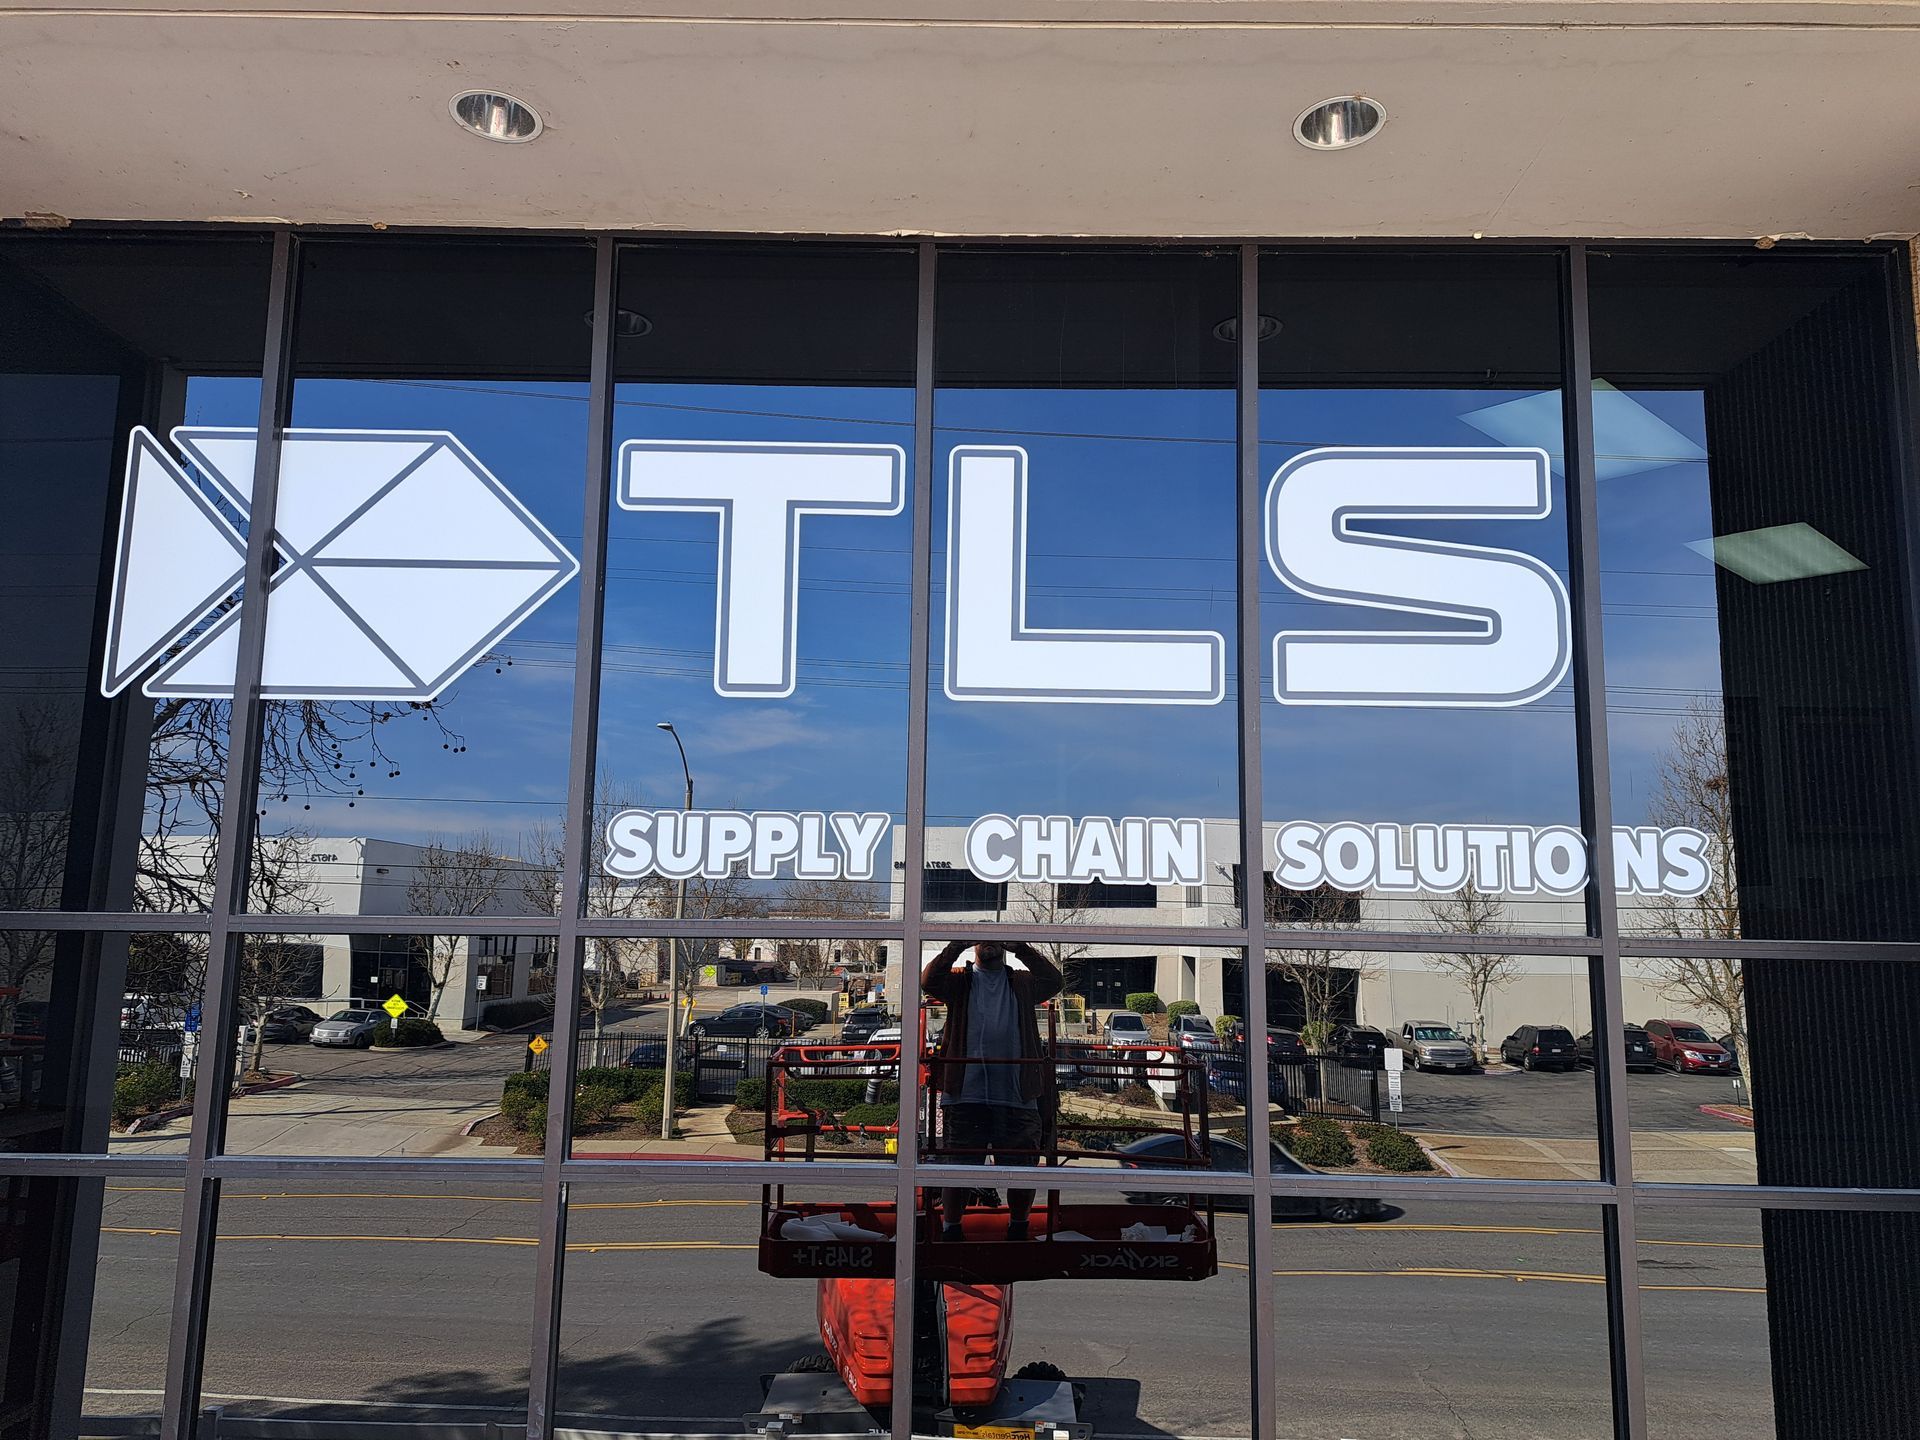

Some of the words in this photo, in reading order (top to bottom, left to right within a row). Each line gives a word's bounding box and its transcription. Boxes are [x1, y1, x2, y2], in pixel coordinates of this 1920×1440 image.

[615, 439, 1573, 708] TLS
[603, 809, 891, 881] SUPPLY
[964, 813, 1206, 887] CHAIN
[1273, 819, 1713, 898] SOLUTIONS
